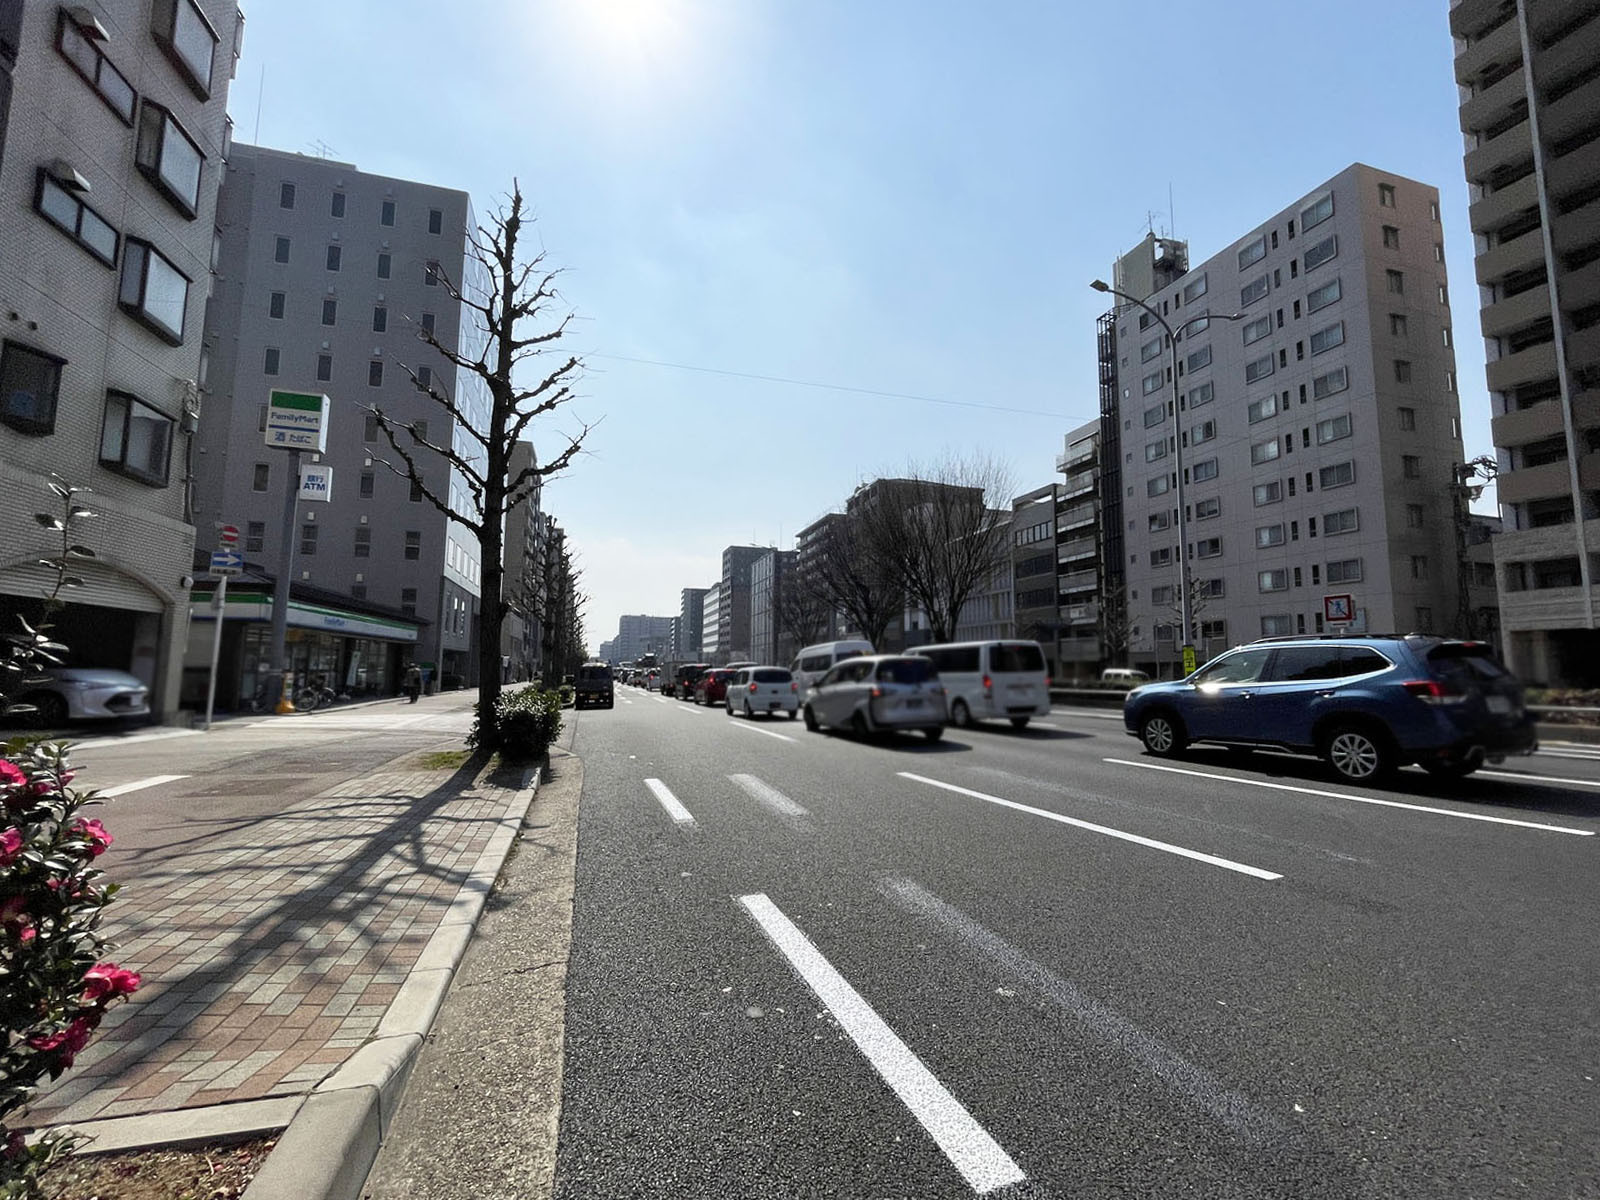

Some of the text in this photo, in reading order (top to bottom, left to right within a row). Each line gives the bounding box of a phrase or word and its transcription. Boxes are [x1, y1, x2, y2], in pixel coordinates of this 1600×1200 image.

[271, 412, 318, 423] FamilyMart
[275, 431, 312, 444] 酒 たばこ
[307, 474, 324, 483] 銀行
[303, 482, 325, 491] ATM
